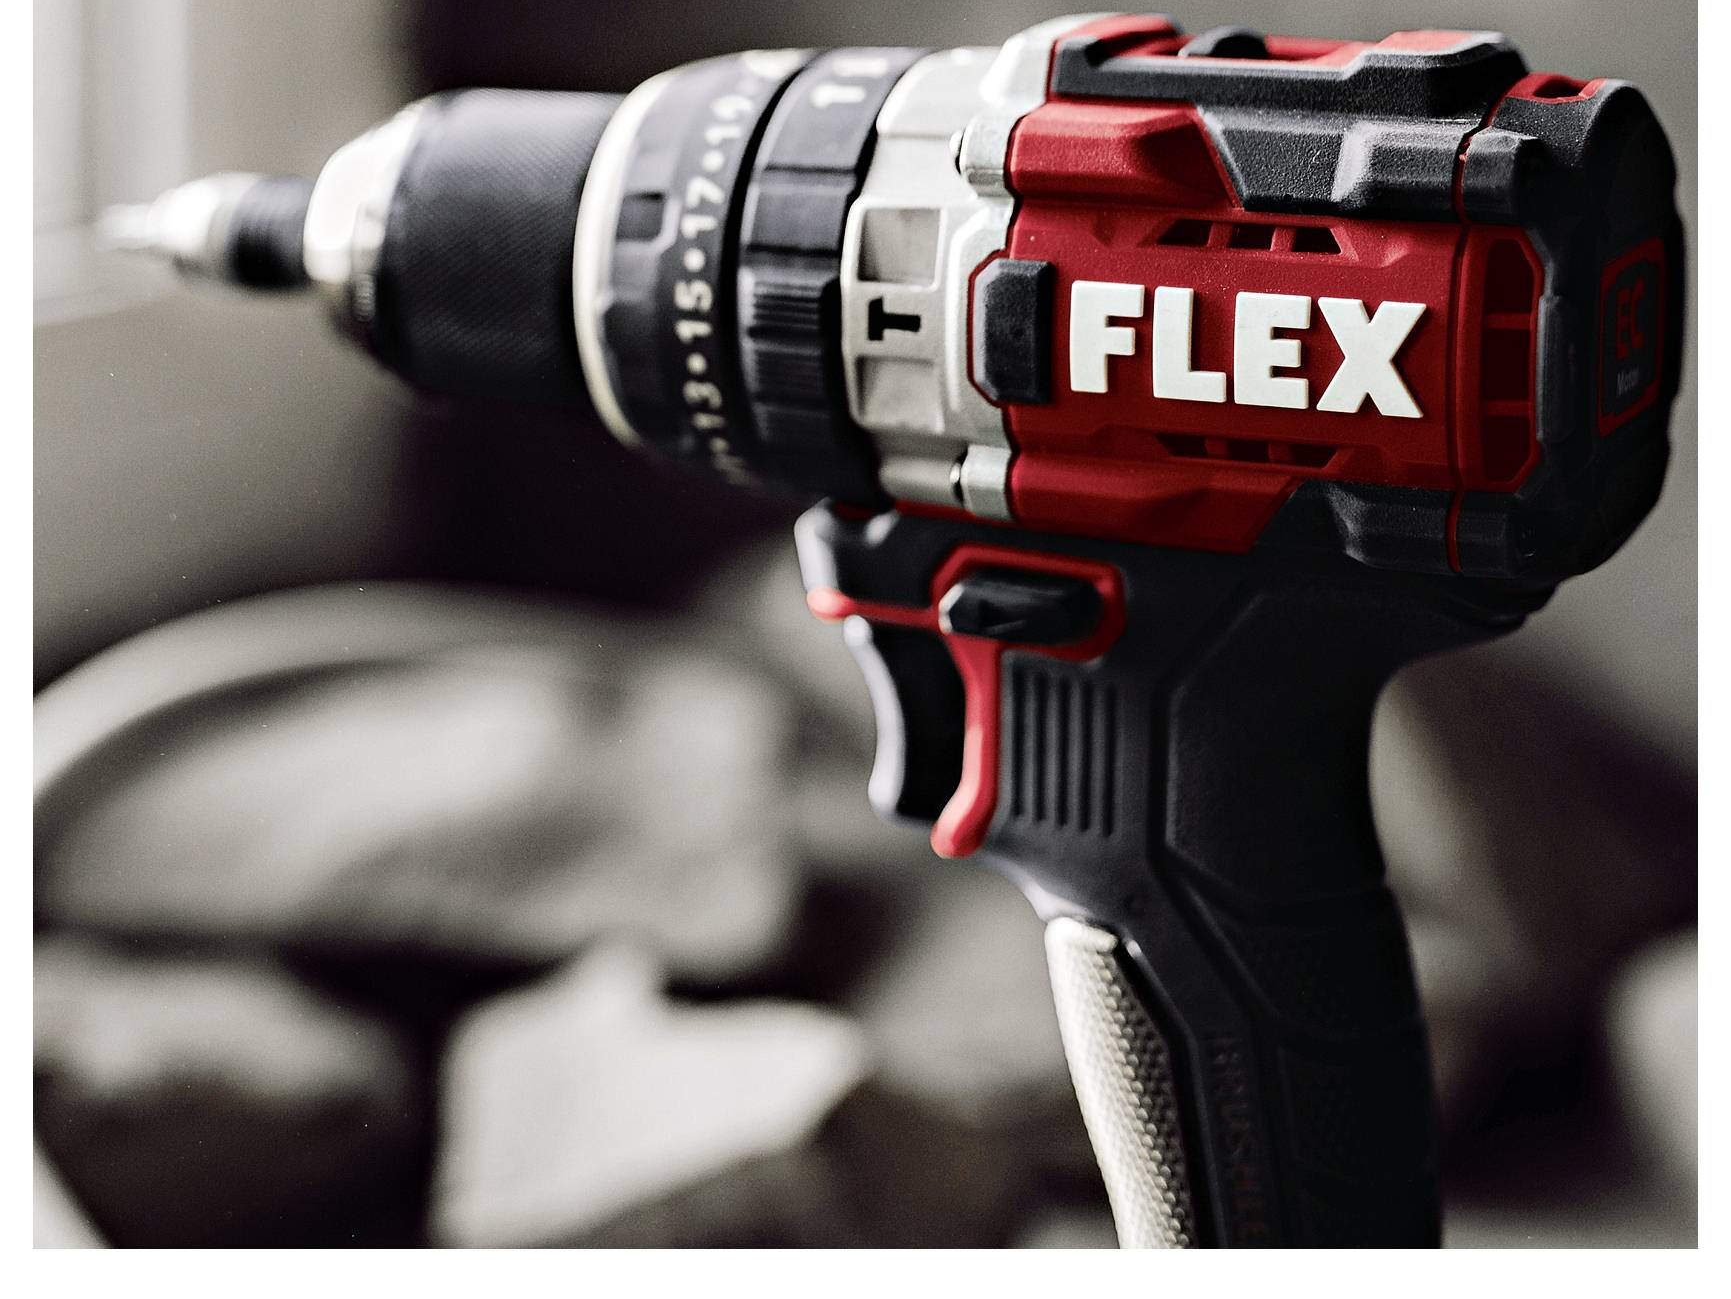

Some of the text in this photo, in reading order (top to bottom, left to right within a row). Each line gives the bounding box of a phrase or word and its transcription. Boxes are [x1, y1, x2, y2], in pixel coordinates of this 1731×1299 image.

[682, 176, 725, 238] 17
[674, 280, 714, 343] 15
[1069, 280, 1427, 418] FLEX
